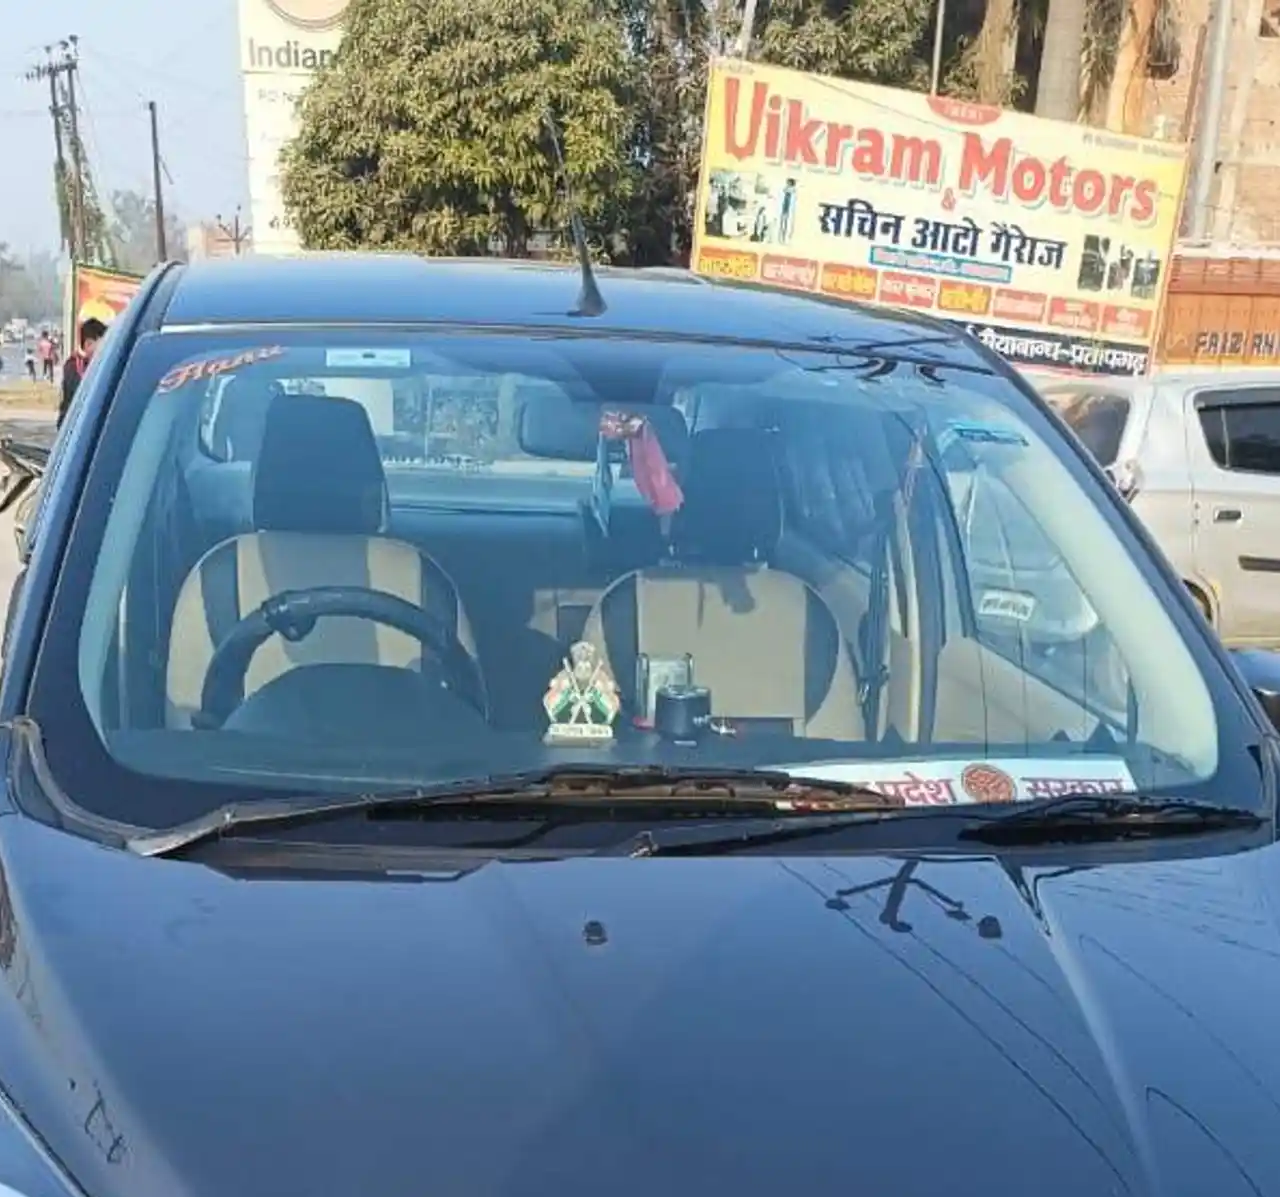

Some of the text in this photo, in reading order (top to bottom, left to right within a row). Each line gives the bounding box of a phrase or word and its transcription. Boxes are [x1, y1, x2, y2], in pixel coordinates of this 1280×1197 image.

[958, 131, 1159, 222] Motors
[817, 198, 905, 244] सचिन
[911, 216, 984, 257] आटो
